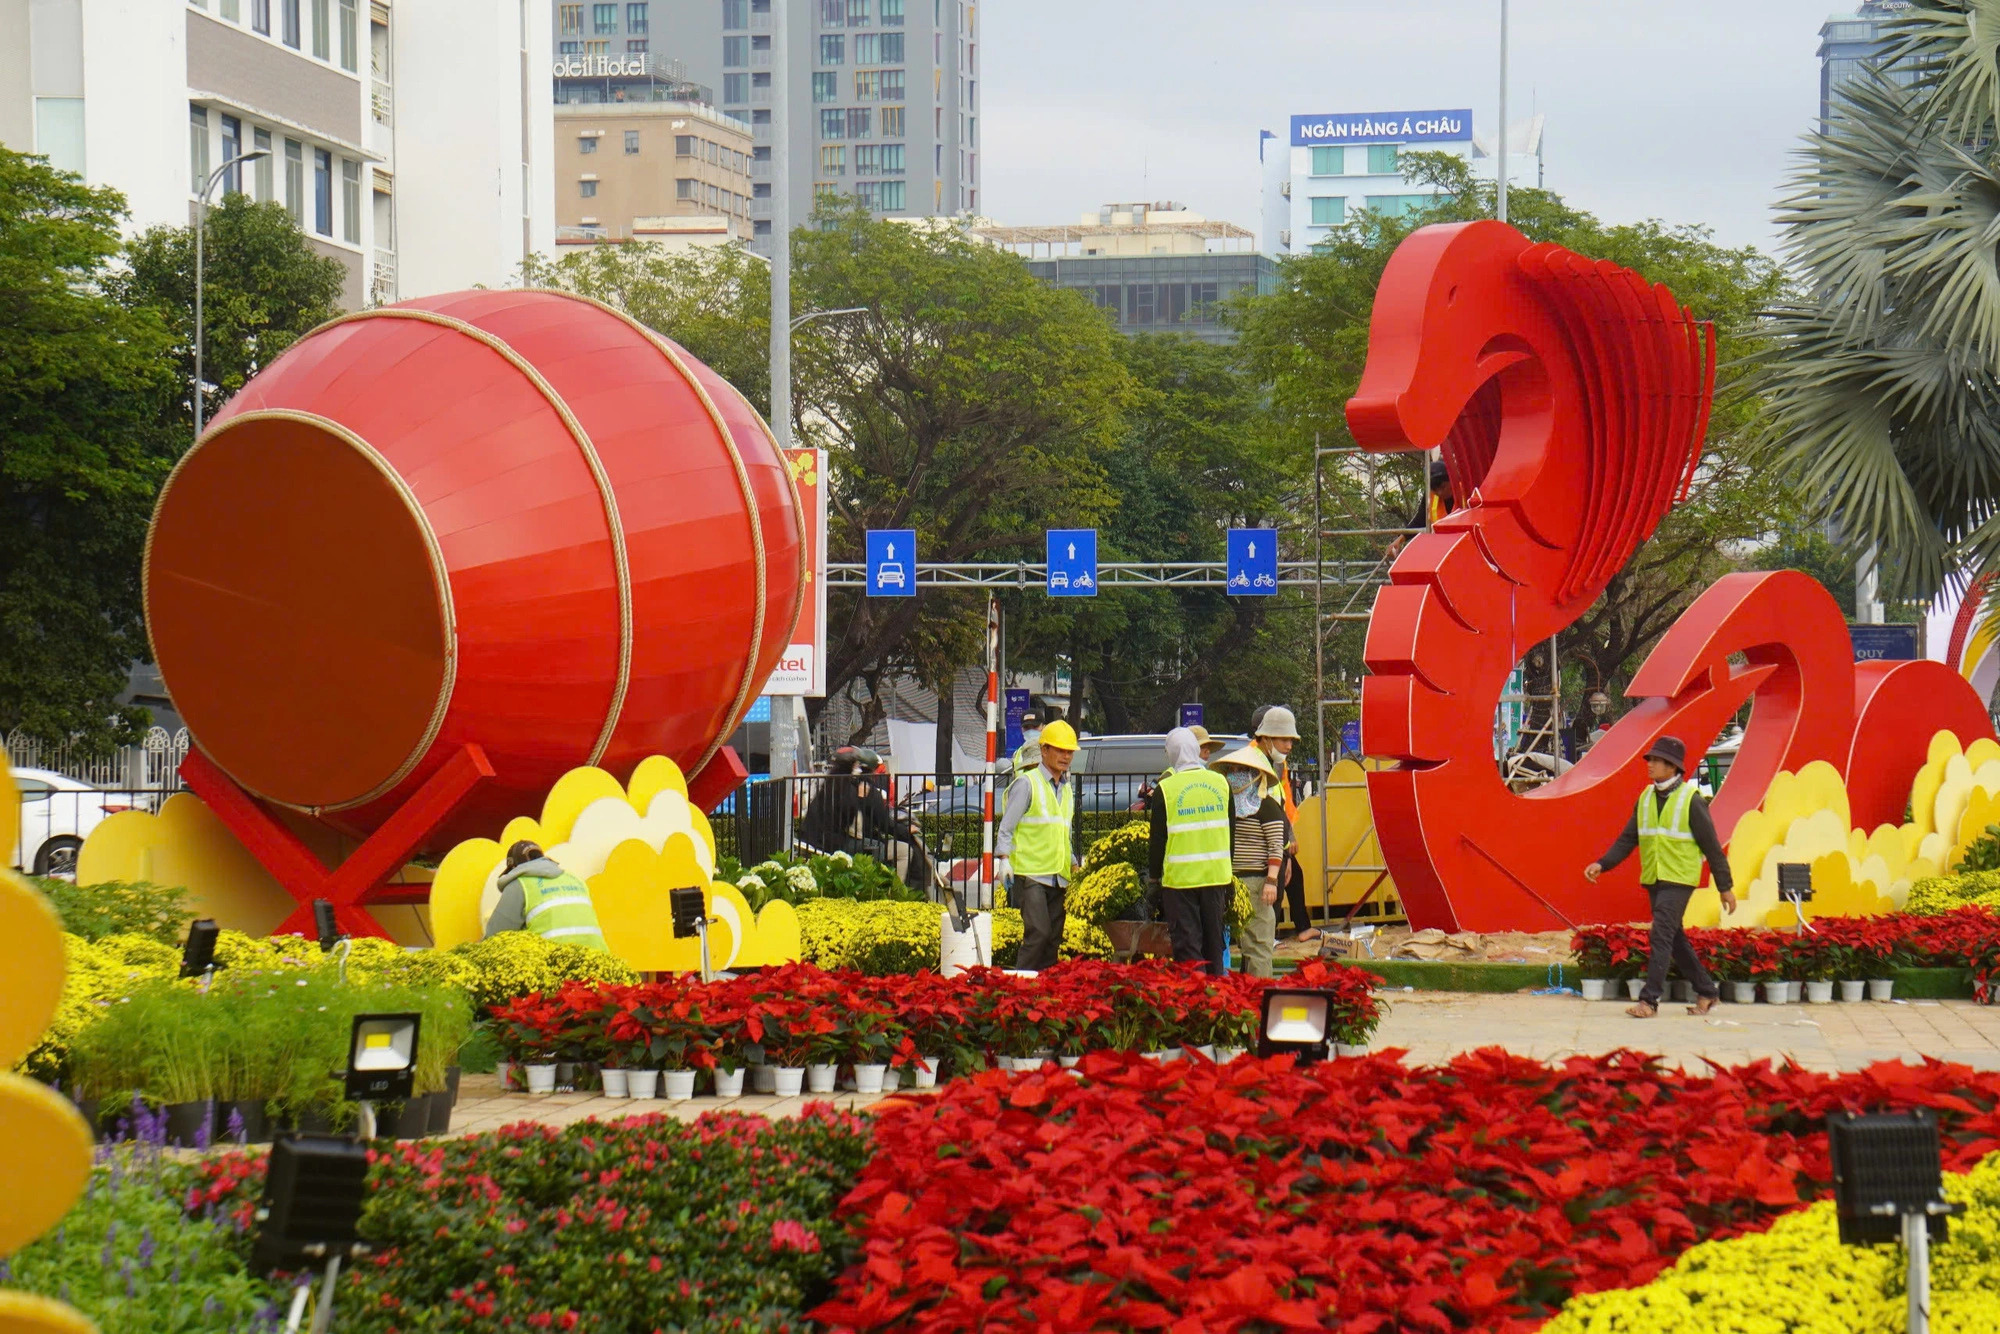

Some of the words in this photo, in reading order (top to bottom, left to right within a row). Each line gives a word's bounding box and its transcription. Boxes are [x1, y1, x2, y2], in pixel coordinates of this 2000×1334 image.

[596, 52, 646, 76] Hotel
[1301, 120, 1348, 138] NGÂN
[1351, 119, 1398, 136] HÀNG
[1401, 117, 1412, 135] Á
[1415, 116, 1461, 134] CHÂU
[1178, 807, 1195, 816] MINH
[370, 1080, 388, 1091] LED
